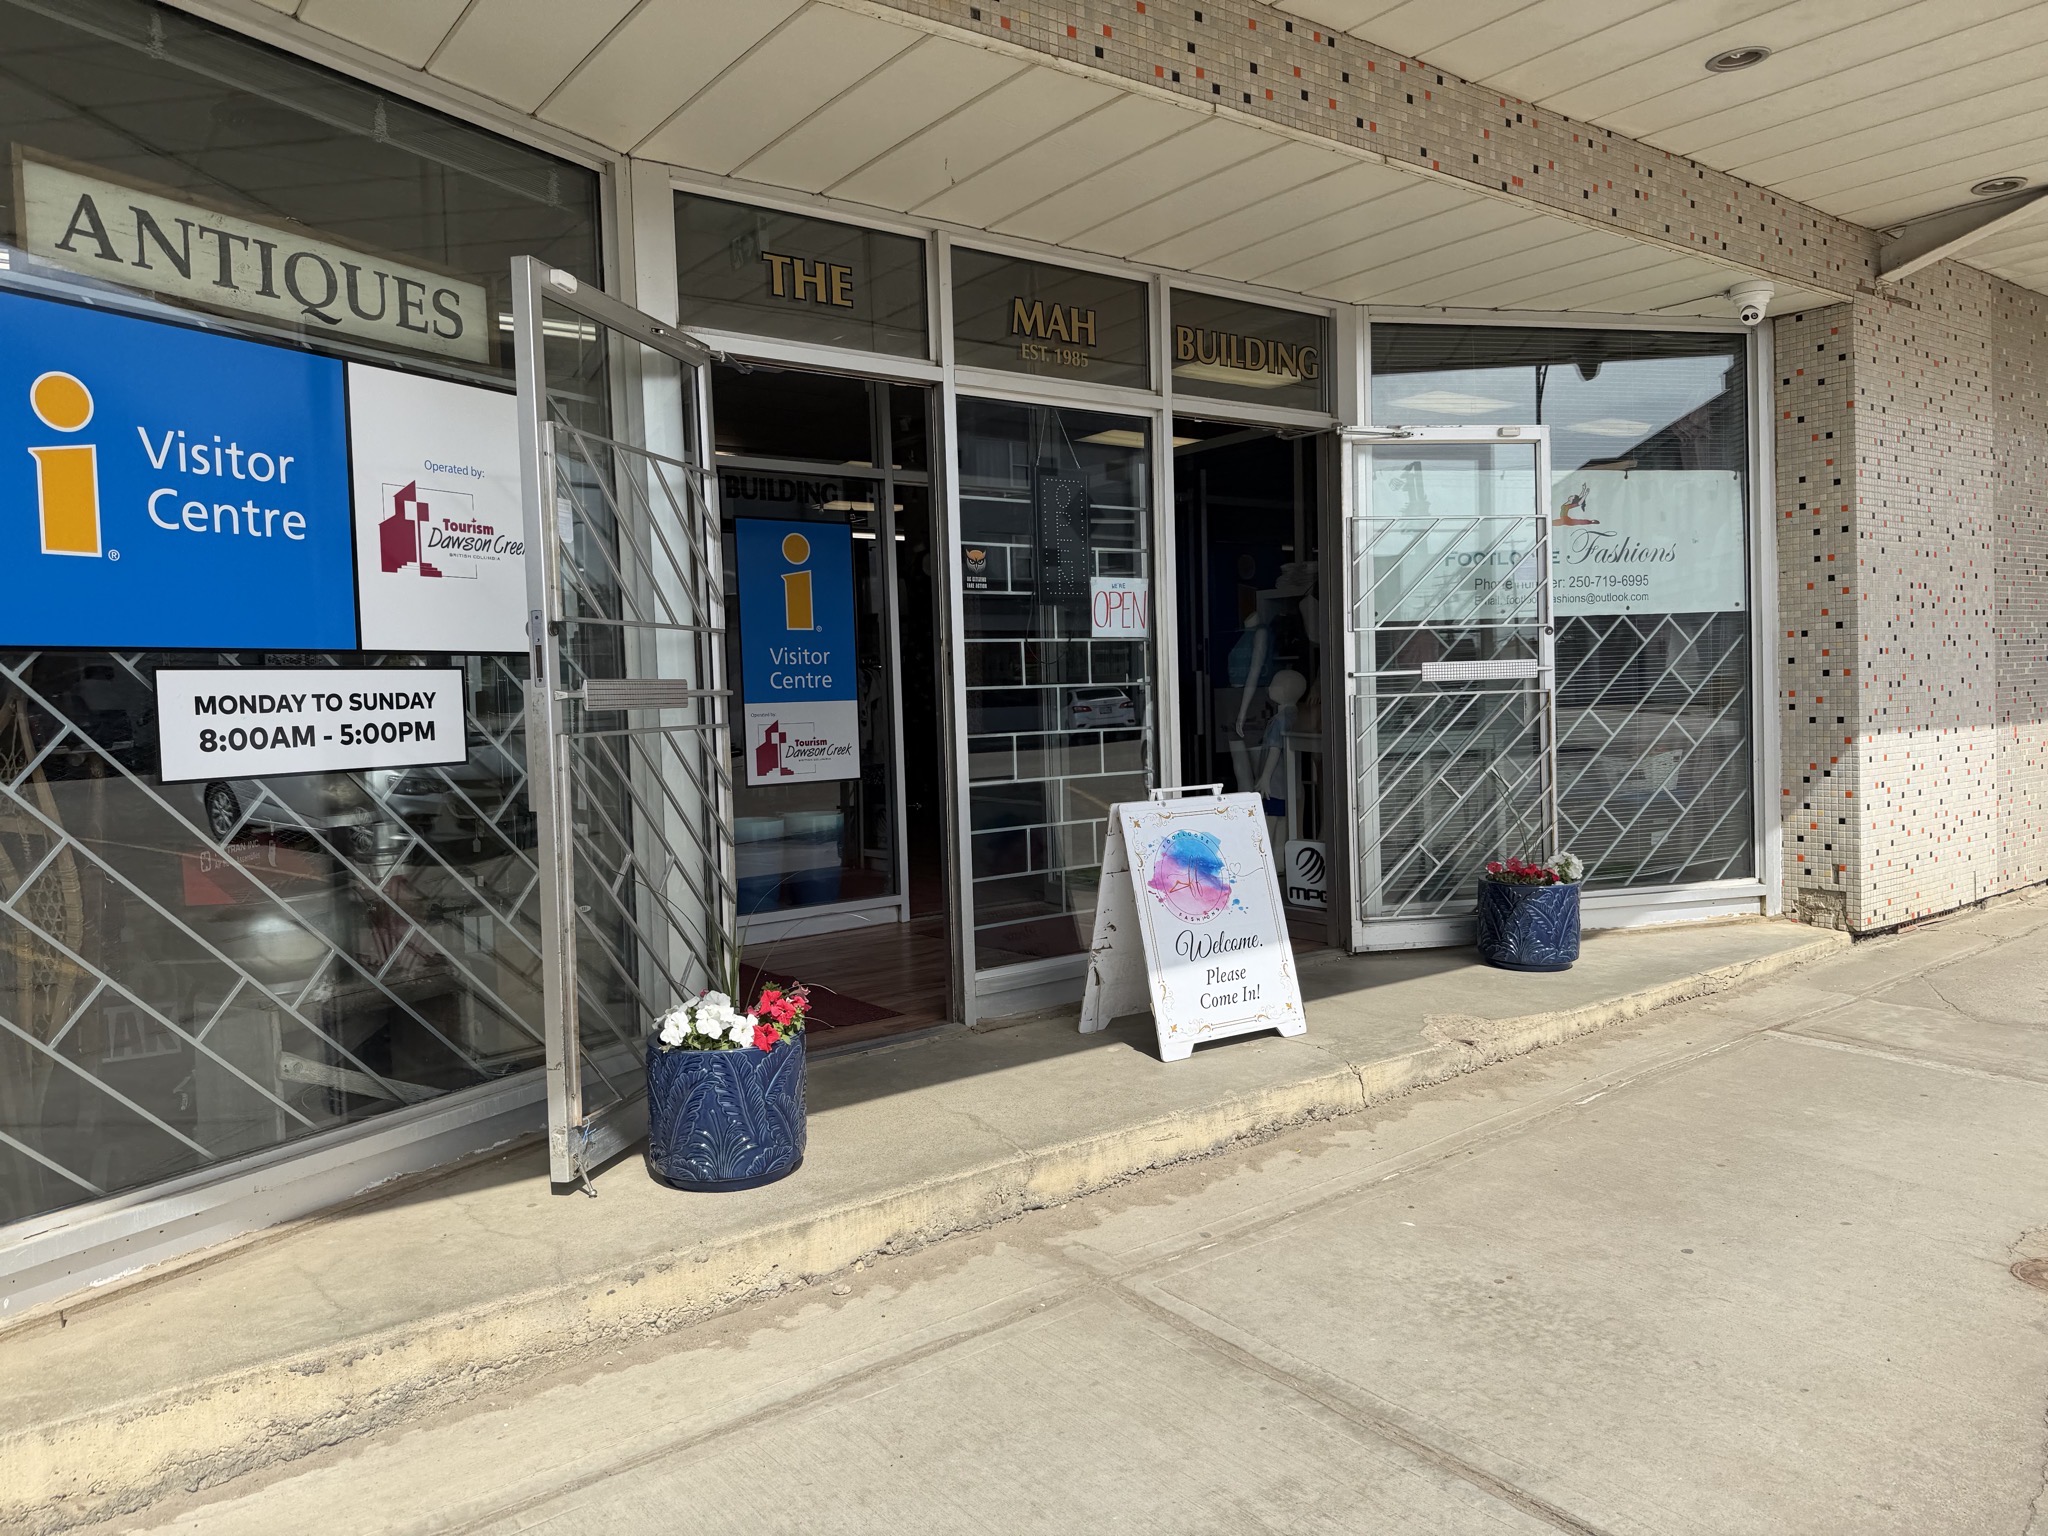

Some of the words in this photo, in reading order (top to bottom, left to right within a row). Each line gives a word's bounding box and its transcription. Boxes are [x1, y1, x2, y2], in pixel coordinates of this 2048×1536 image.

[55, 193, 464, 340] ANTIQUES
[761, 251, 854, 309] THE
[1012, 296, 1096, 347] MAH
[1021, 342, 1049, 363] EST.
[1054, 347, 1089, 368] 1985
[1176, 325, 1319, 380] BUILDING
[137, 426, 295, 484] Visitor
[424, 460, 469, 476] Operated
[471, 466, 485, 479] by:
[724, 474, 839, 504] BUILDING
[148, 488, 307, 541] Centre
[442, 517, 495, 536] Tourism
[428, 527, 492, 552] Dawson
[493, 535, 526, 556] Cree
[1445, 550, 1560, 567] FOOTLOE
[1567, 528, 1677, 565] Fashions
[1474, 578, 1513, 591] Phoe
[1568, 574, 1649, 588] 250-719-6995
[1093, 590, 1147, 629] OPEN
[769, 647, 831, 666] Visitor
[769, 671, 833, 690] Centre
[194, 693, 307, 716] MONDAY
[311, 692, 343, 713] TO
[349, 691, 437, 712] SUNDAY
[199, 725, 316, 753] 8:00AM
[340, 720, 436, 746] 5:00PM
[785, 745, 826, 759] Dawson
[826, 742, 853, 757] Creek
[794, 736, 828, 747] Tourism
[1162, 831, 1210, 849] FOOTLOOSE
[1175, 929, 1263, 962] Welcome.
[1206, 966, 1247, 986] Please
[1200, 992, 1239, 1010] Come
[1242, 983, 1261, 1003] In!
